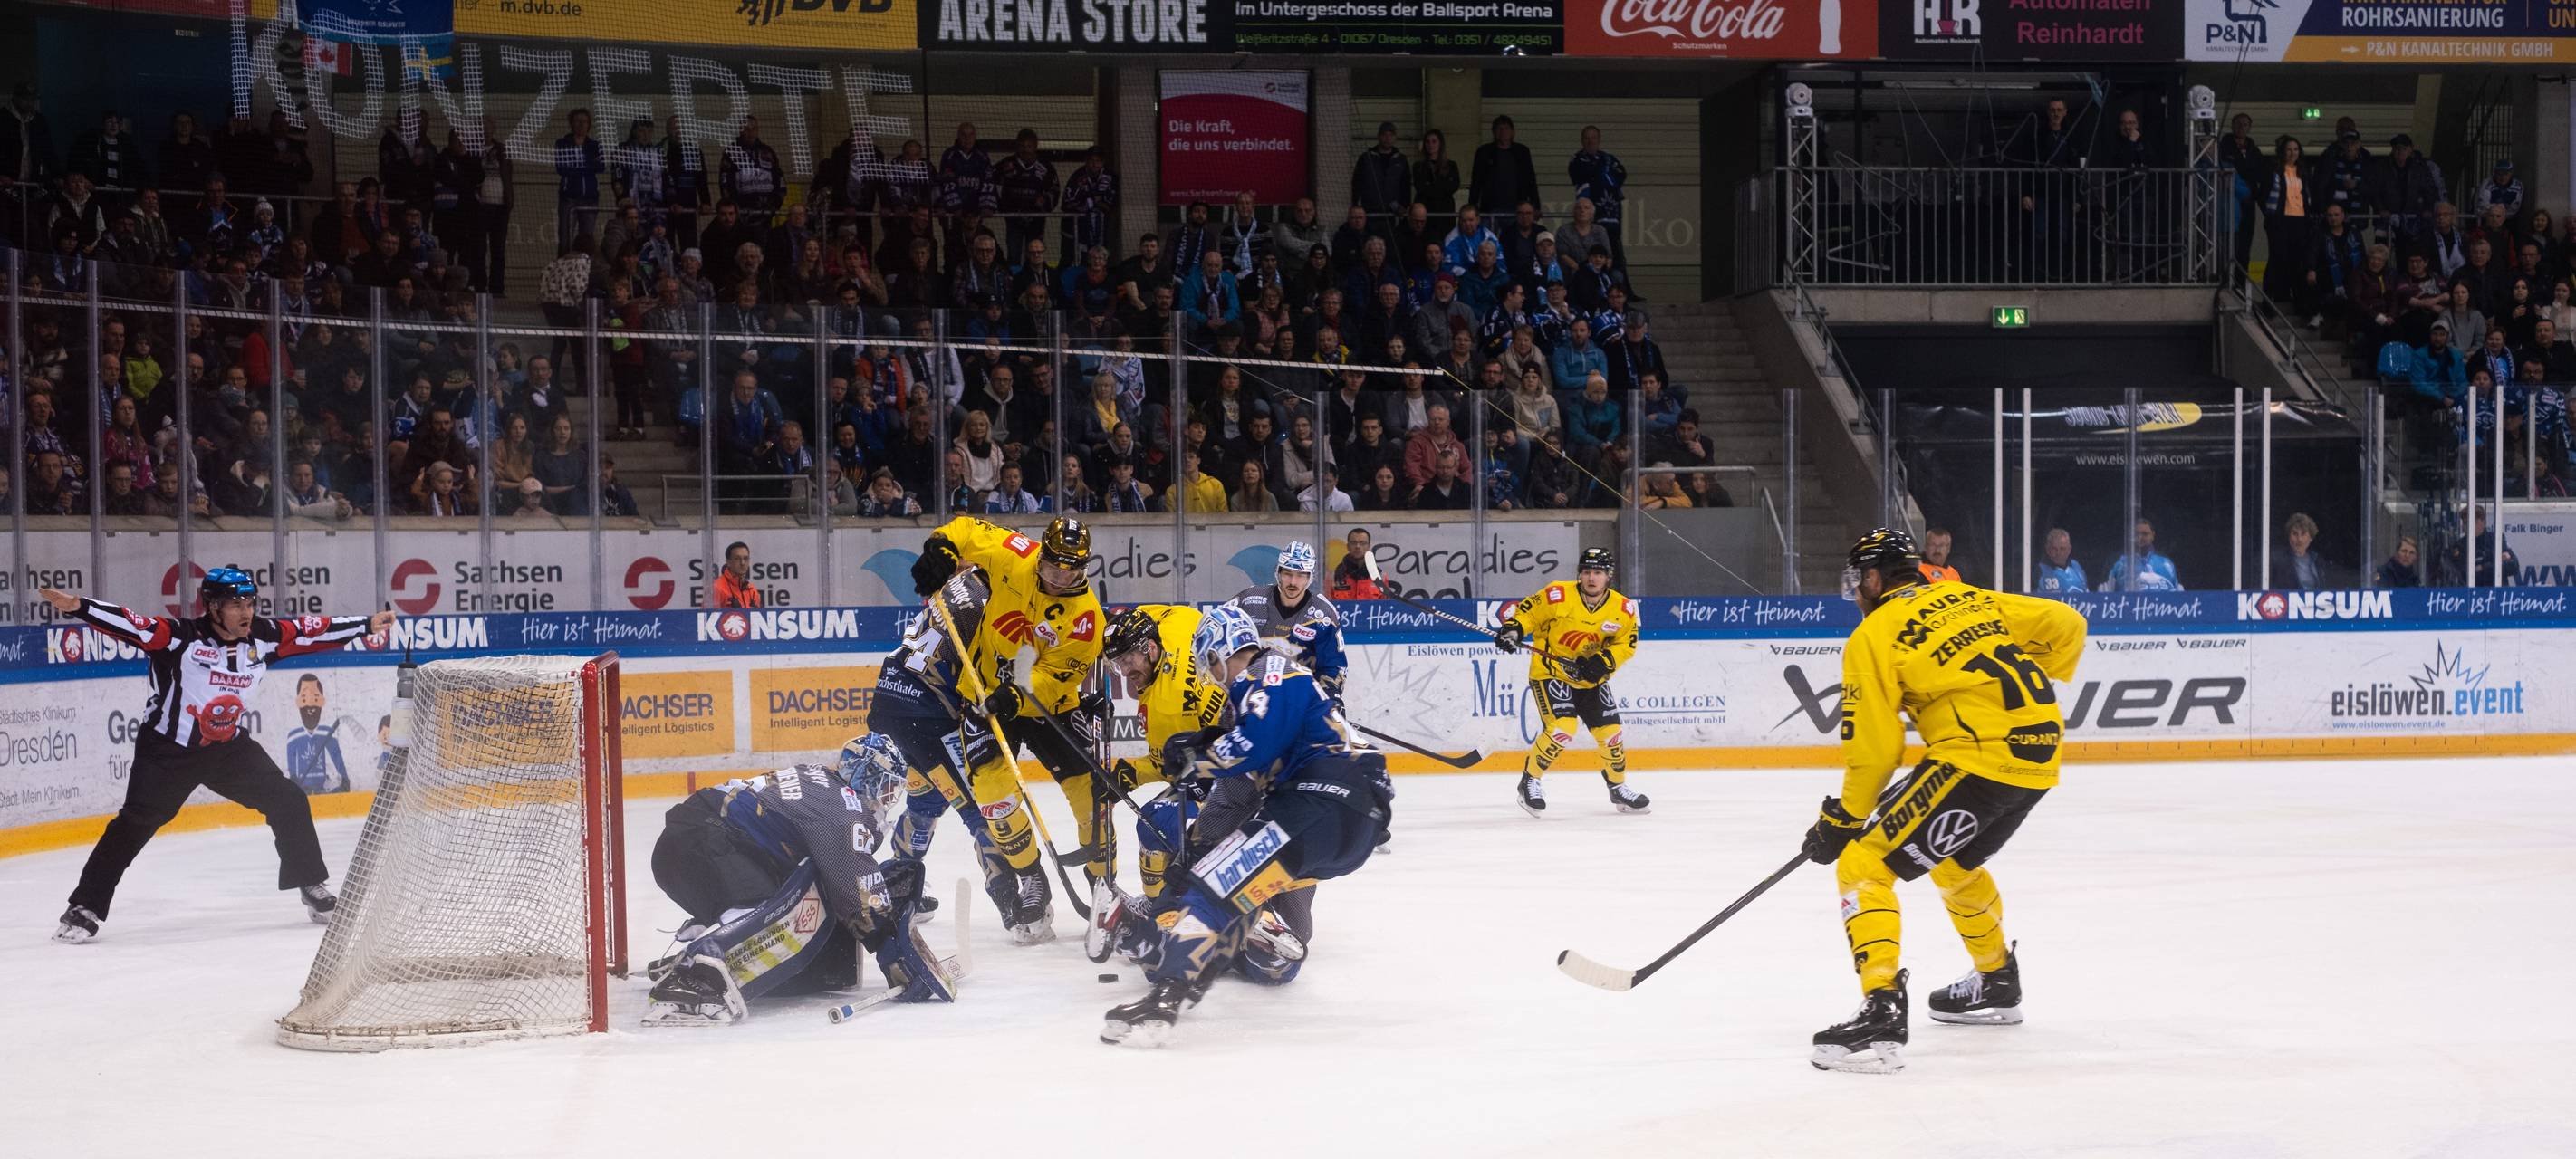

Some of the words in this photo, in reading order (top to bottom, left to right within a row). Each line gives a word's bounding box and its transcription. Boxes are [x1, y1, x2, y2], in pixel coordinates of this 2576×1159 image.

[1235, 3, 1253, 16] Im
[1258, 1, 1388, 19] Untergeschoss
[1391, 3, 1414, 16] der
[1423, 3, 1498, 21] Ballsport
[1503, 4, 1553, 18] Arena
[2342, 7, 2504, 28] ROHRSANIERUNG
[938, 0, 1072, 42] ARENA
[1082, 0, 1207, 43] STORE
[1321, 34, 1330, 43] 4
[1341, 33, 1375, 43] 01067
[1378, 34, 1421, 44] Dresden
[1456, 34, 1482, 45] 0351
[1493, 34, 1552, 46] 48249451
[2017, 22, 2144, 44] Reinhardt
[2206, 24, 2256, 43] P&N
[1673, 42, 1727, 50] Schutzmarken
[2367, 43, 2396, 58] P&N
[2401, 43, 2506, 58] KANALTECHNIK
[2511, 43, 2553, 58] GMBH
[1168, 120, 1192, 133] Die
[1196, 119, 1235, 135] Kraft,
[1168, 138, 1190, 151] die
[1195, 140, 1219, 151] uns
[1223, 138, 1295, 151] verbindet.
[2075, 453, 2196, 465] www.eislewen.com
[2504, 523, 2526, 534] Falk
[2530, 523, 2564, 536] Binger
[1370, 532, 1560, 575] Paradies
[454, 560, 562, 584] Sachsen
[455, 588, 554, 613] Energie
[2101, 596, 2127, 619] ist
[2134, 597, 2203, 621] Heimat.
[2237, 590, 2393, 621] KONSUM
[2427, 590, 2465, 616] Hier
[2471, 590, 2496, 613] ist
[2499, 591, 2567, 616] Heimat.
[1044, 603, 1065, 621] C
[1679, 600, 1718, 625] Hier
[1723, 600, 1750, 623] ist
[1754, 600, 1826, 626] Heimat.
[521, 616, 558, 644] Hier
[563, 615, 589, 643] ist
[593, 614, 663, 644] Heimat.
[697, 610, 859, 642] KONSUM
[1408, 644, 1465, 657] Eislöwen
[1783, 646, 1842, 656] BAUER
[2108, 639, 2167, 652] BAUER
[2189, 638, 2247, 649] BAUER
[1960, 642, 2056, 711] 16
[1636, 695, 1726, 709] COLLEGEN
[2331, 680, 2524, 716] eislöwen.event
[620, 693, 714, 721] ACHSER
[770, 717, 825, 731] Intelligent
[828, 715, 868, 729] Logisti
[1705, 714, 1726, 725] mbH
[621, 723, 661, 736] elligent
[664, 722, 715, 735] Logistics
[1296, 781, 1350, 798] BAUER
[765, 934, 785, 949] HAND
